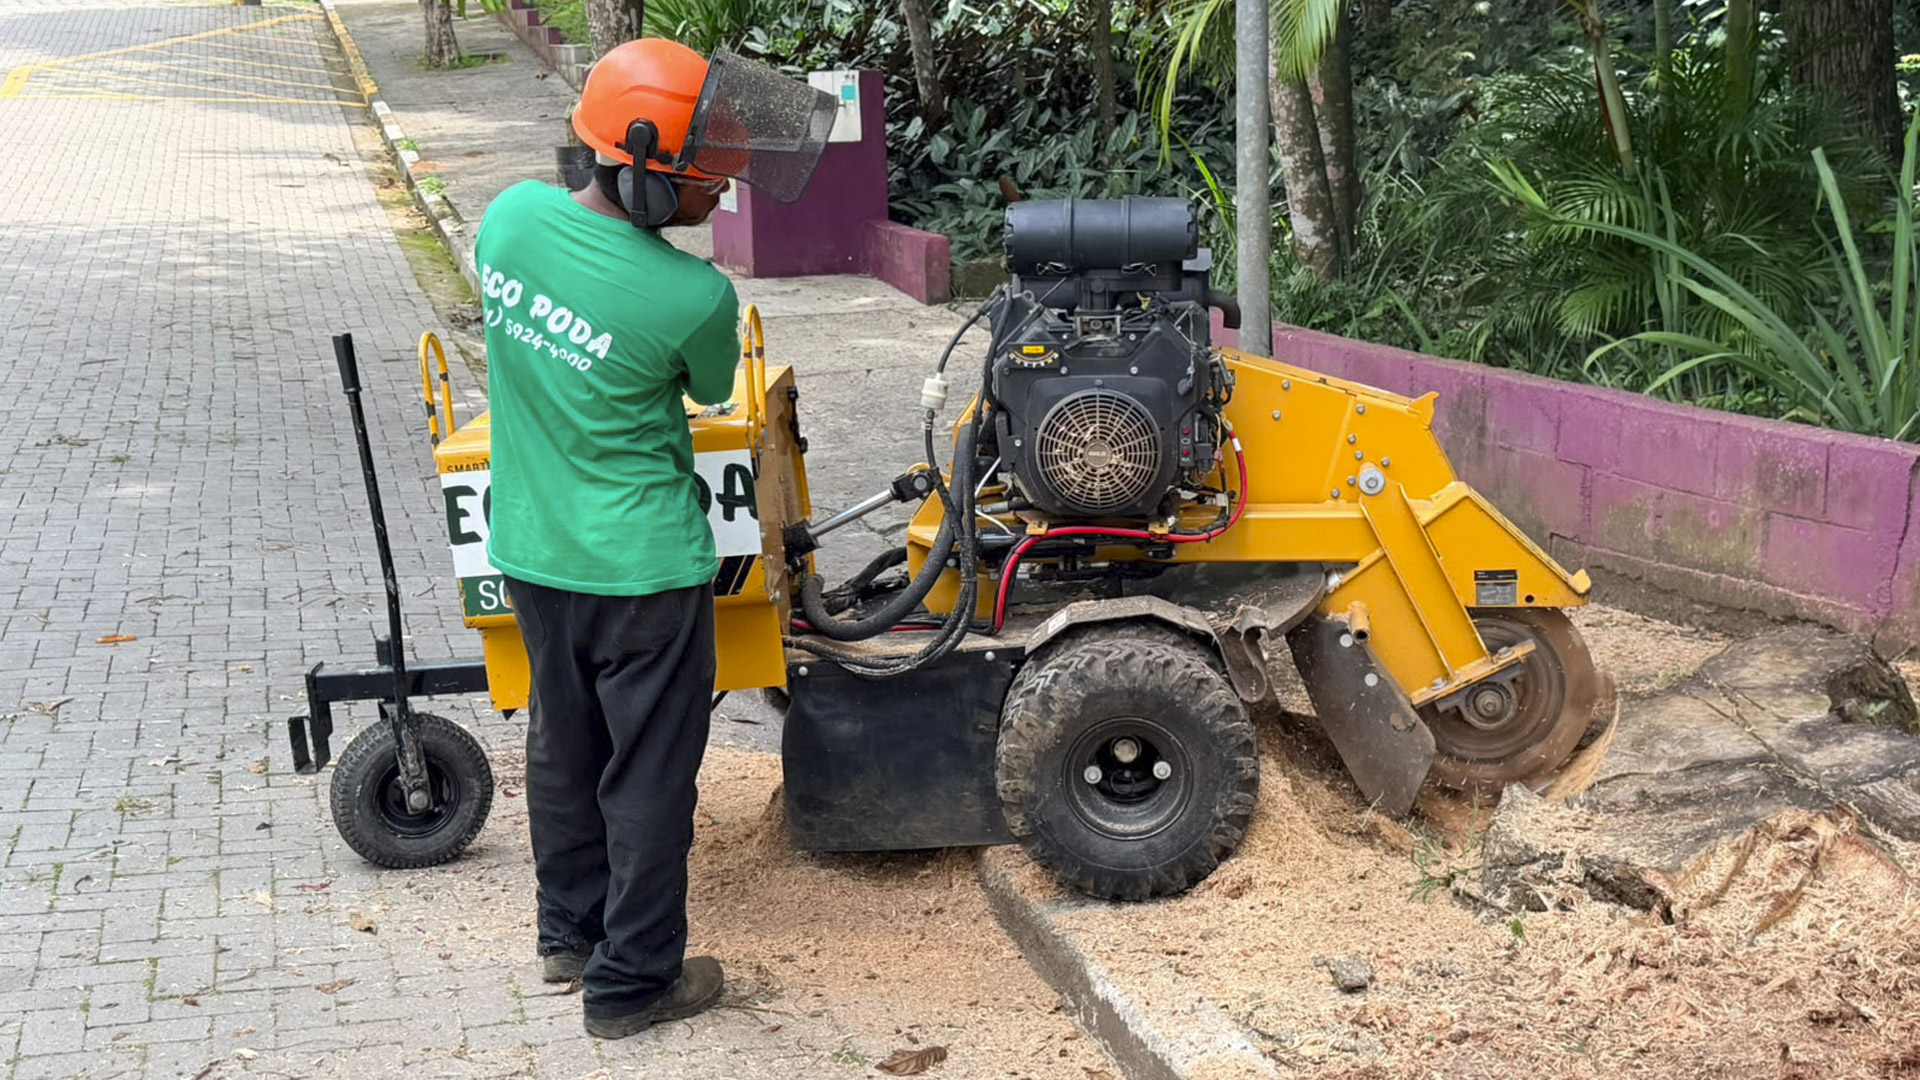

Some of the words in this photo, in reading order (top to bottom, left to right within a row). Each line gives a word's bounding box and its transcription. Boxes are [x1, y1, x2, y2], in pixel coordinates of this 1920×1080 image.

[482, 263, 523, 308] ECO
[529, 294, 613, 360] PODA
[505, 318, 592, 371] 5924-4000
[443, 485, 491, 546] E
